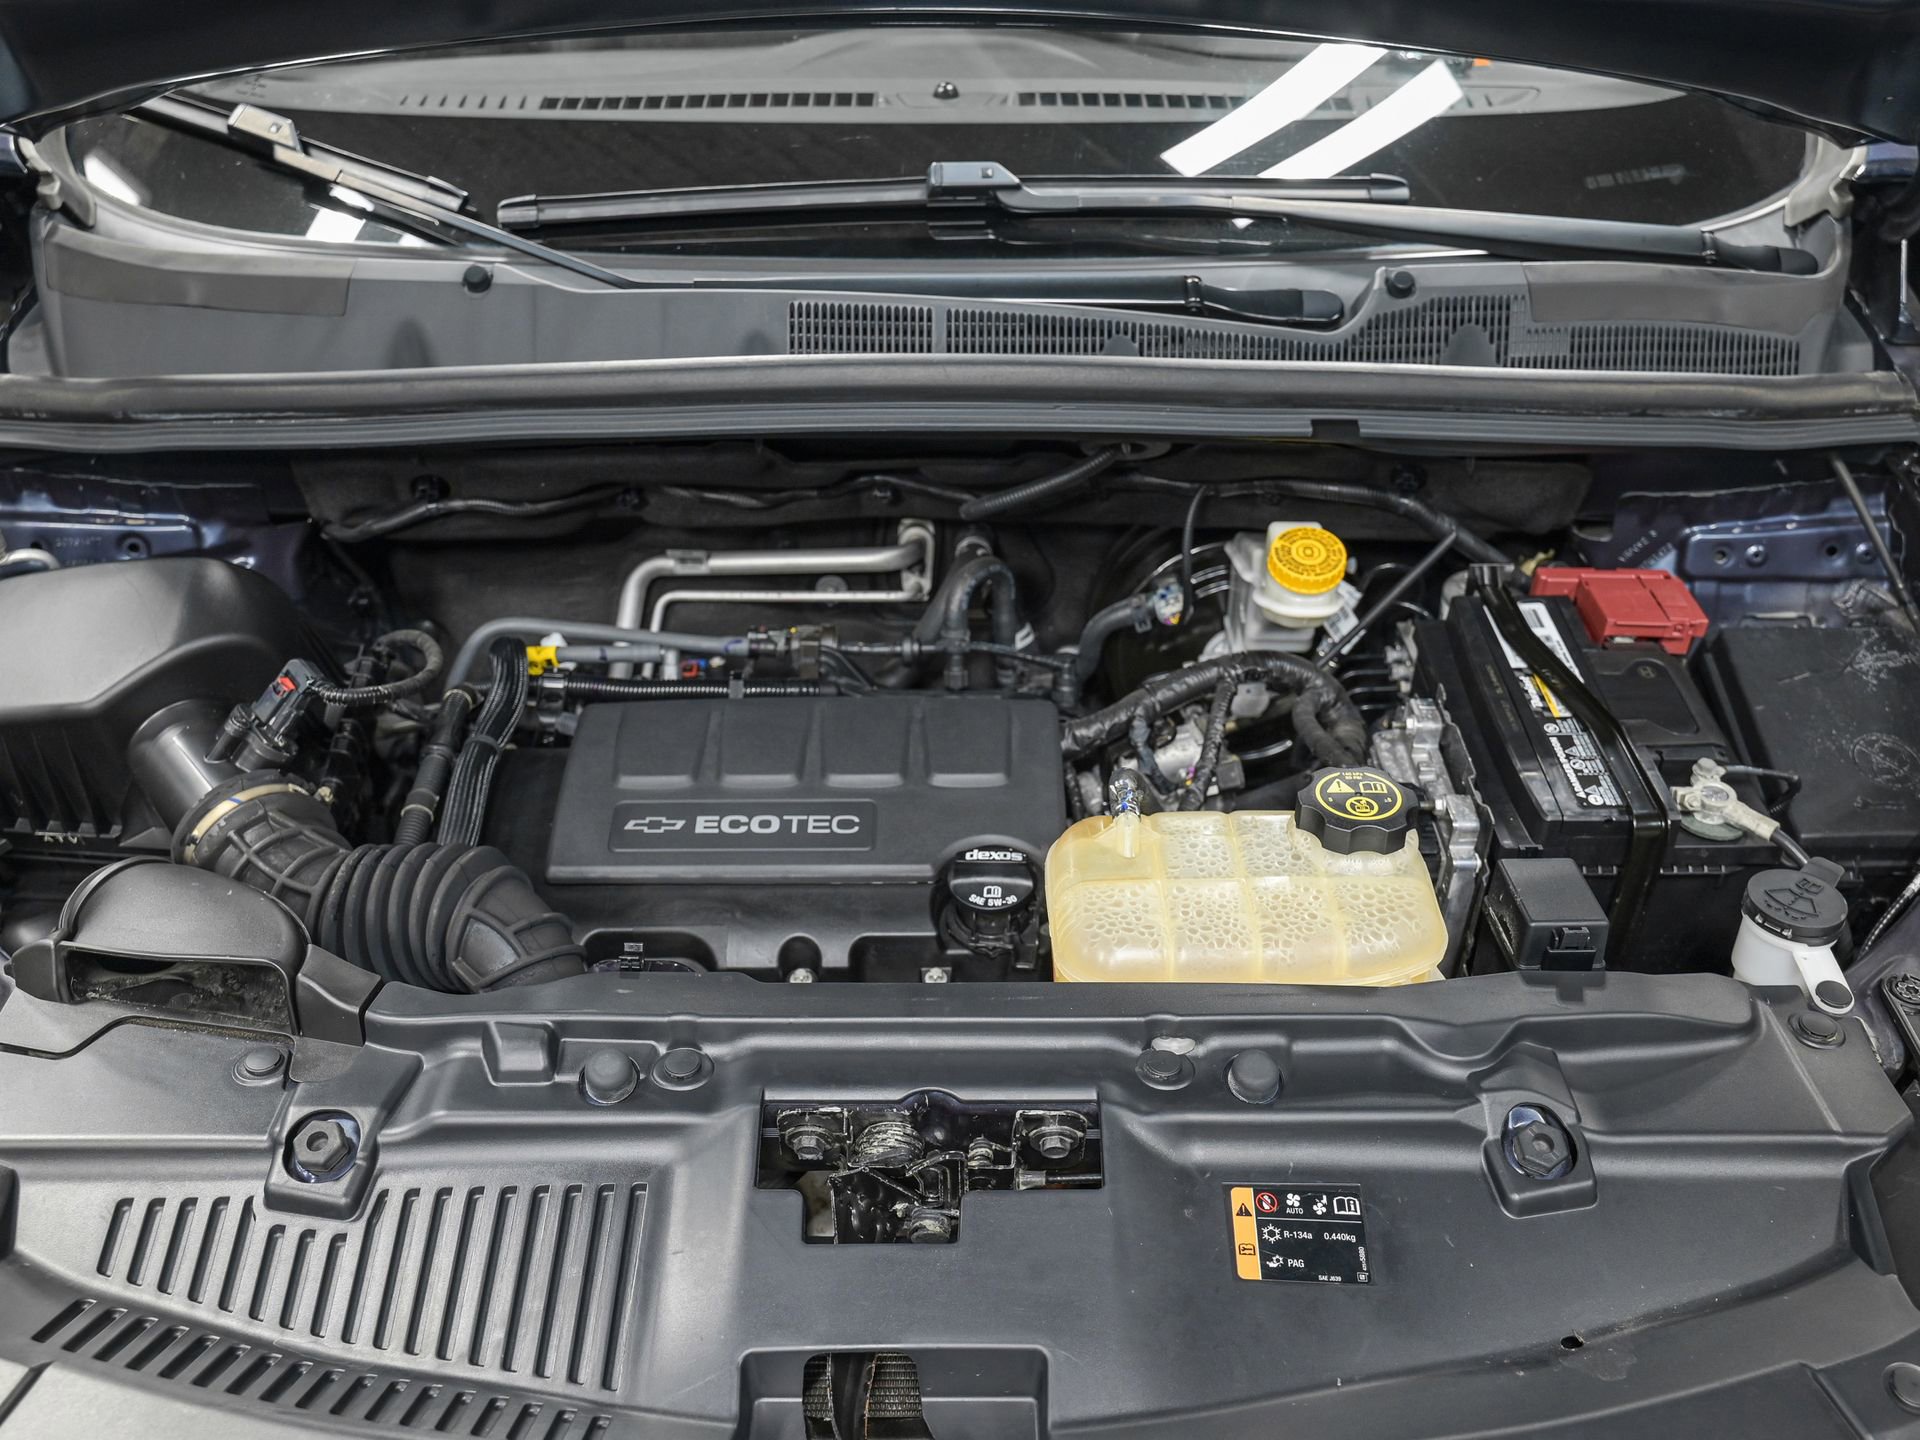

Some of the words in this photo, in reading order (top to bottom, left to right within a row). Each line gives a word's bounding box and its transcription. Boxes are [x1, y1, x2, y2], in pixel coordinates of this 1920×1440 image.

[694, 814, 861, 834] ECOTEC
[965, 848, 1024, 861] dexos
[968, 893, 986, 906] SAE
[987, 894, 1018, 907] 5W-30
[1286, 1207, 1304, 1215] AUTO
[1283, 1231, 1313, 1240] R-134a
[1323, 1232, 1357, 1243] 0.440kg
[1287, 1259, 1305, 1268] PAG
